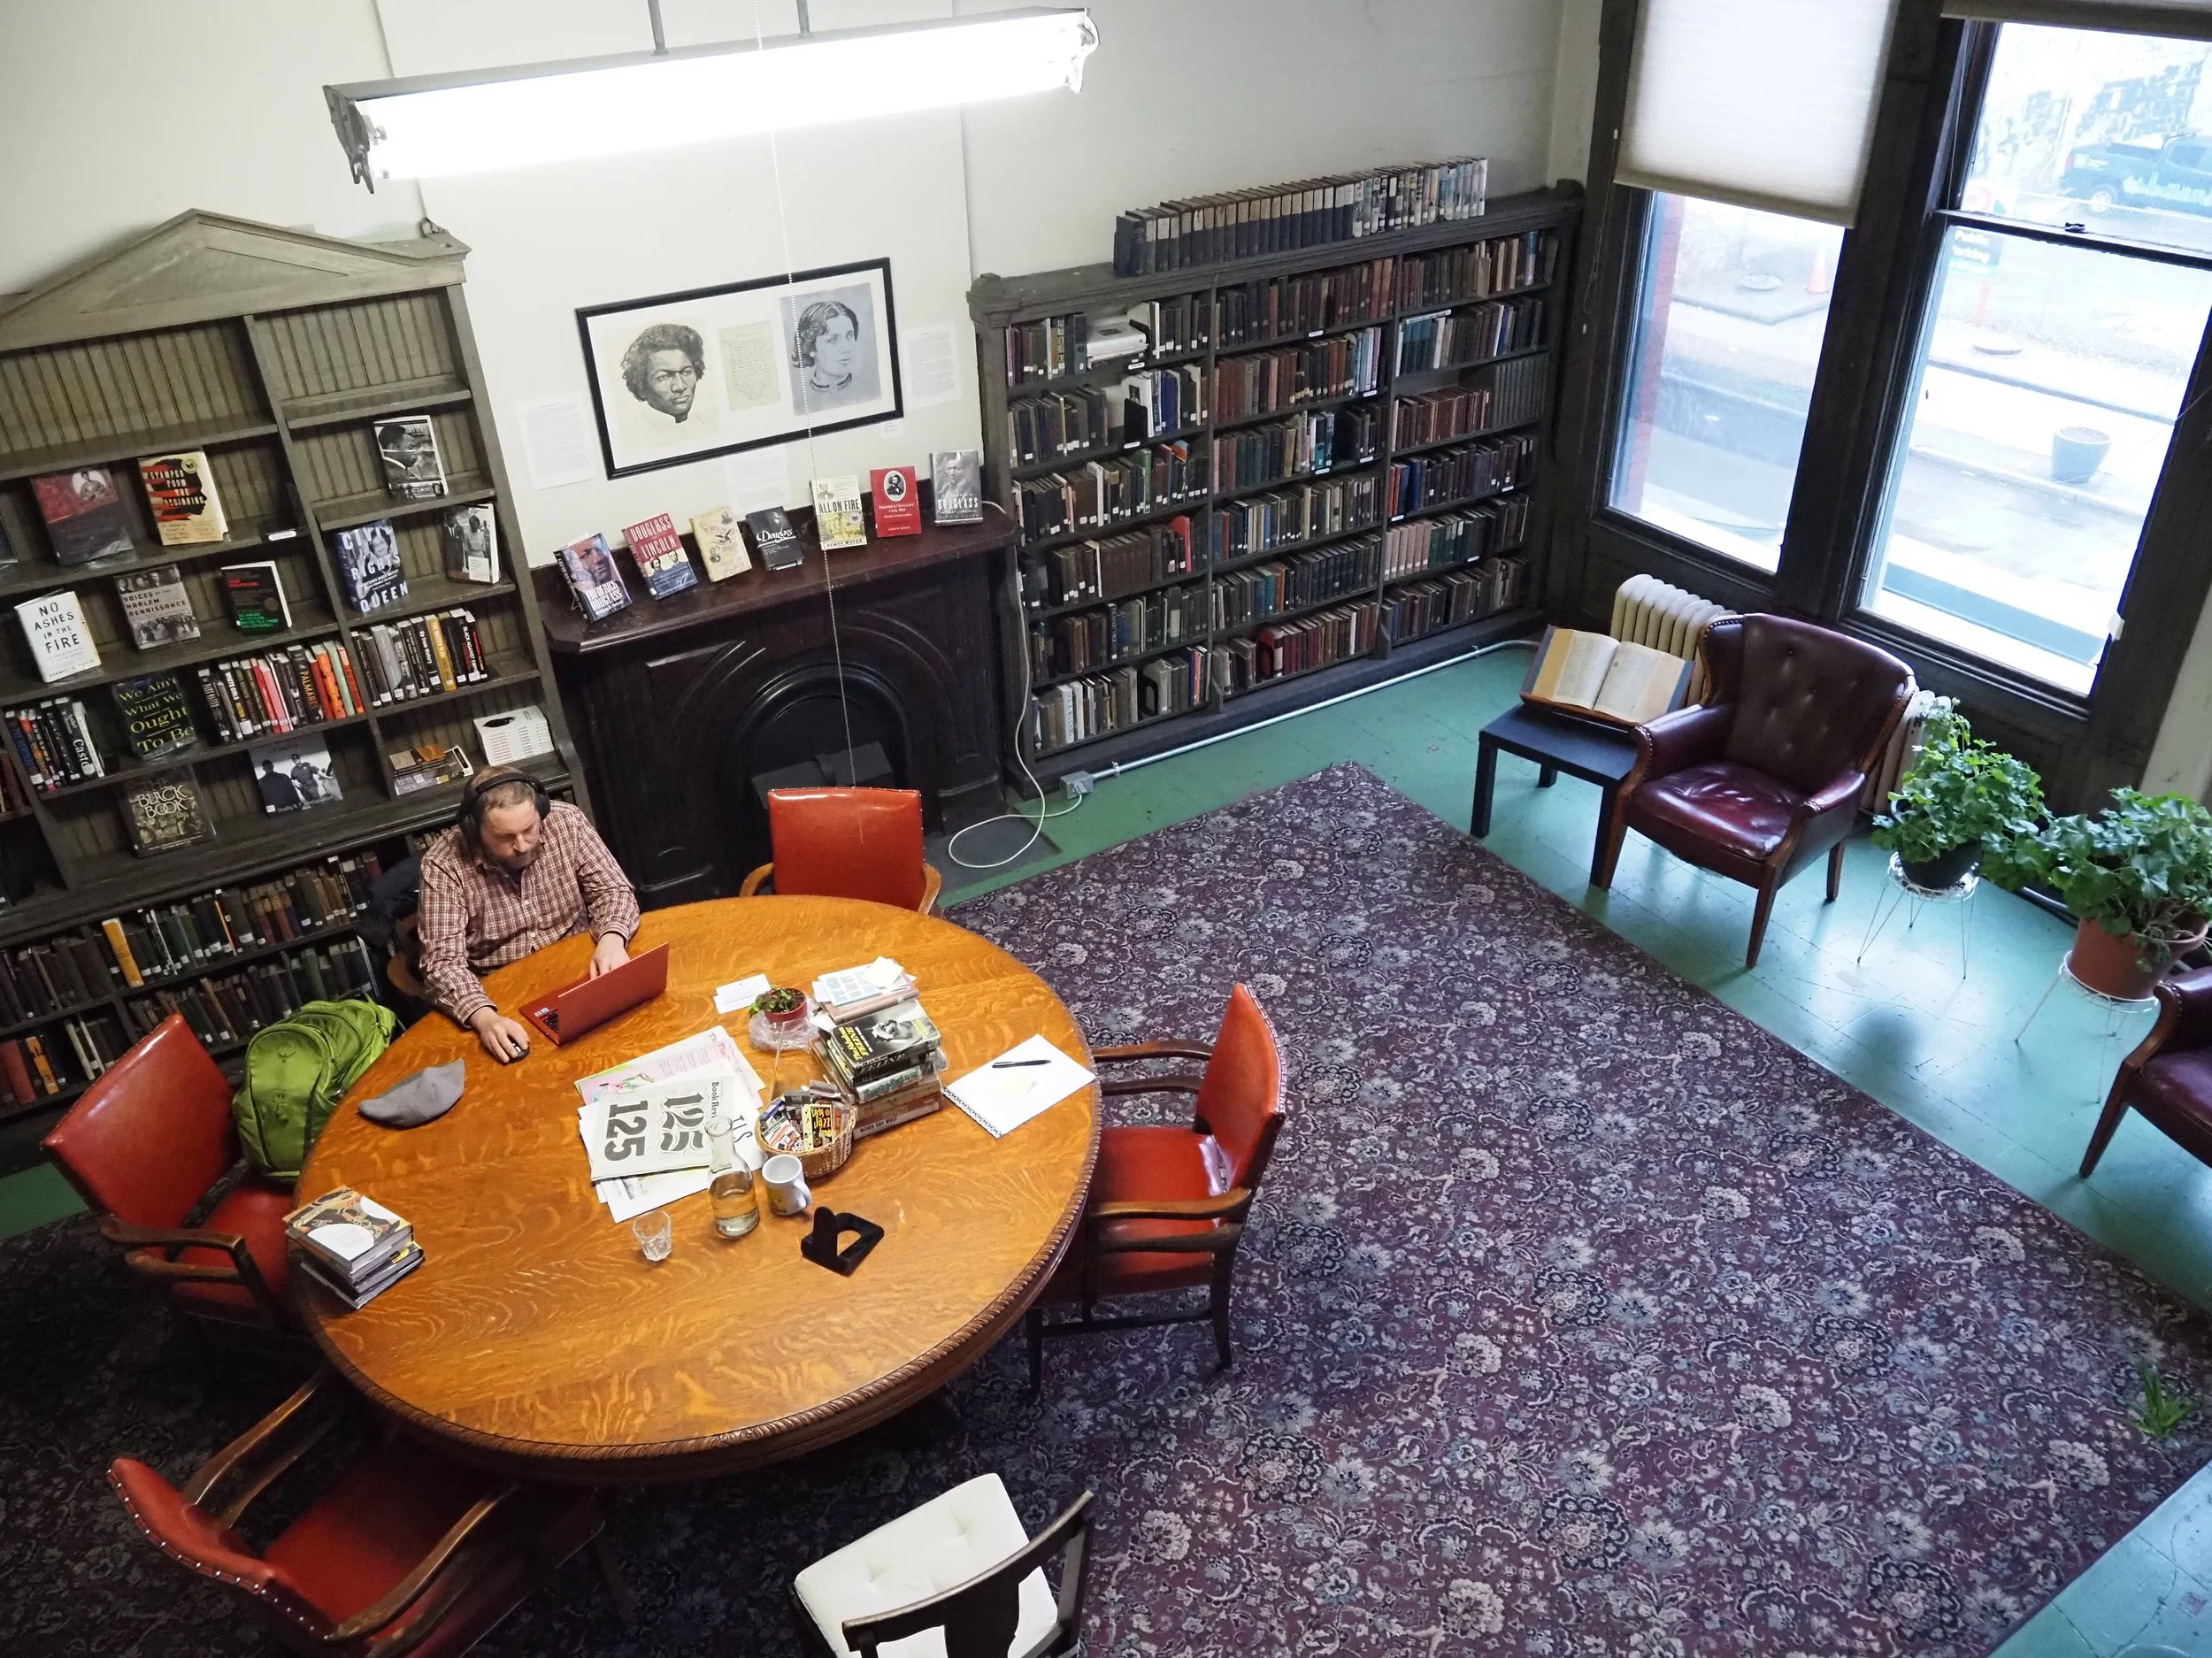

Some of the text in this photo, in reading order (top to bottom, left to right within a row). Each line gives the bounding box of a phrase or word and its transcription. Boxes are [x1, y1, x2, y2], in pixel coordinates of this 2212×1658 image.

[818, 498, 860, 513] ALL ON FIRE
[938, 497, 979, 510] DOUGLASS
[342, 526, 394, 550] CIVIL
[629, 515, 672, 542] DOUGLASS
[641, 534, 677, 559] LINCOLN
[350, 551, 401, 580] RIGHTS
[123, 591, 154, 603] VOICES
[126, 598, 159, 610] HARLEM
[360, 580, 409, 612] QUEEN
[38, 602, 59, 617] NO
[128, 600, 187, 617] RENAISSANCE
[35, 611, 75, 631] ASHES
[43, 625, 73, 640] IN THE
[45, 633, 81, 654] FIRE
[119, 678, 177, 702] We Ain't
[124, 693, 182, 717] What We
[130, 706, 188, 733] Ought
[136, 725, 195, 752] To Be
[73, 738, 89, 768] Caste
[135, 785, 188, 808] BLACK
[144, 797, 188, 818] BOOK
[603, 1100, 649, 1162] 125
[815, 1117, 831, 1128] Jazz
